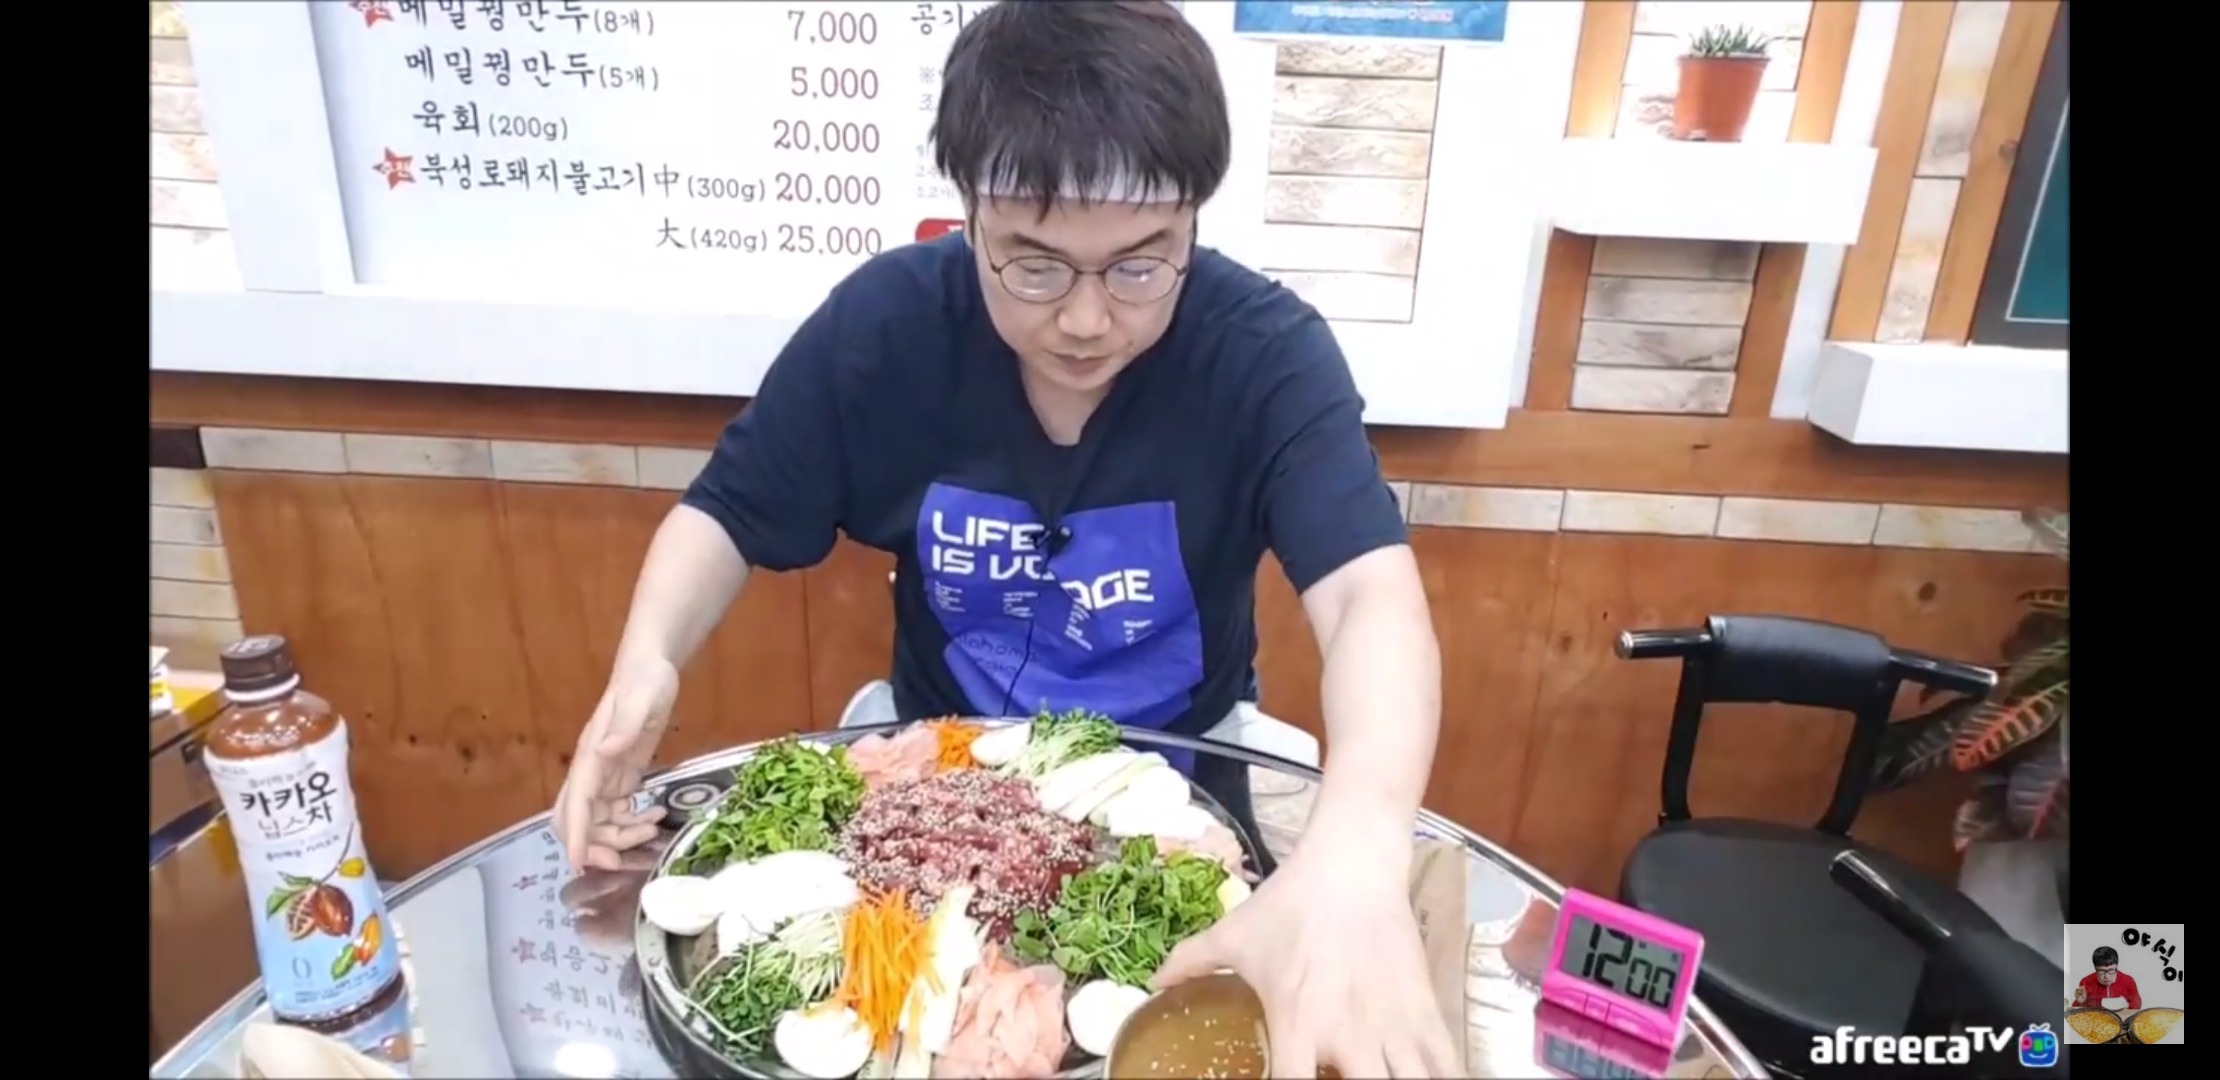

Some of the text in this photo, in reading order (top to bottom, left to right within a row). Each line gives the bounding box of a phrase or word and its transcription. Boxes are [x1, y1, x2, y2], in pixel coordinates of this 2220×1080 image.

[787, 10, 877, 45] 7,000
[791, 66, 879, 100] 5,000
[773, 119, 880, 153] 20,000
[775, 172, 881, 206] 20,000
[778, 222, 883, 257] 25,000
[932, 510, 1045, 551] LIFE
[932, 544, 976, 576] IS
[239, 770, 338, 818] 카카오
[257, 800, 334, 840] 닙스차
